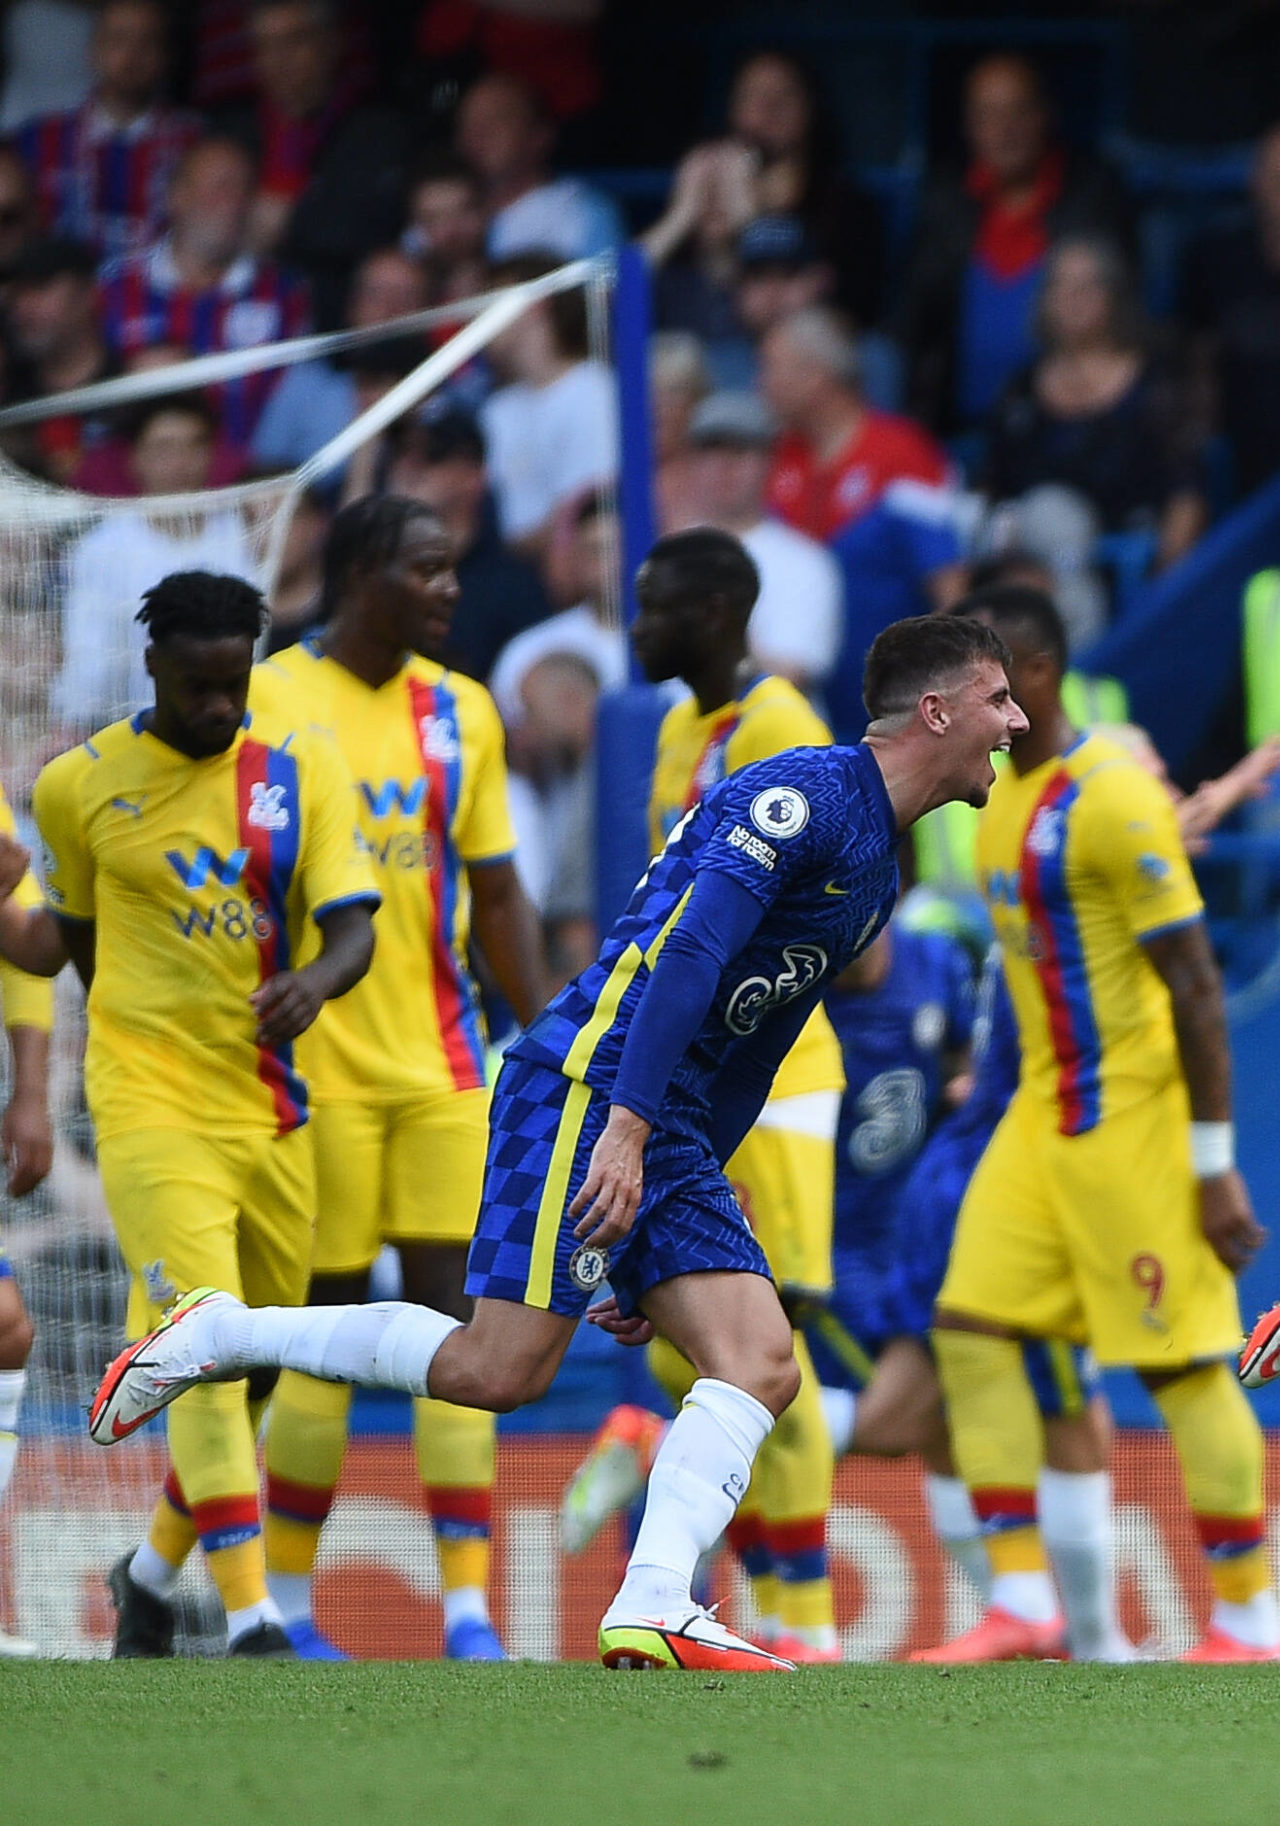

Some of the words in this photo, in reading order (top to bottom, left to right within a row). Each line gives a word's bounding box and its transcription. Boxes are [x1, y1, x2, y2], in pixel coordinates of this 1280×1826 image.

[748, 836, 777, 861] room
[169, 897, 273, 942] W88
[1130, 1252, 1166, 1312] 9
